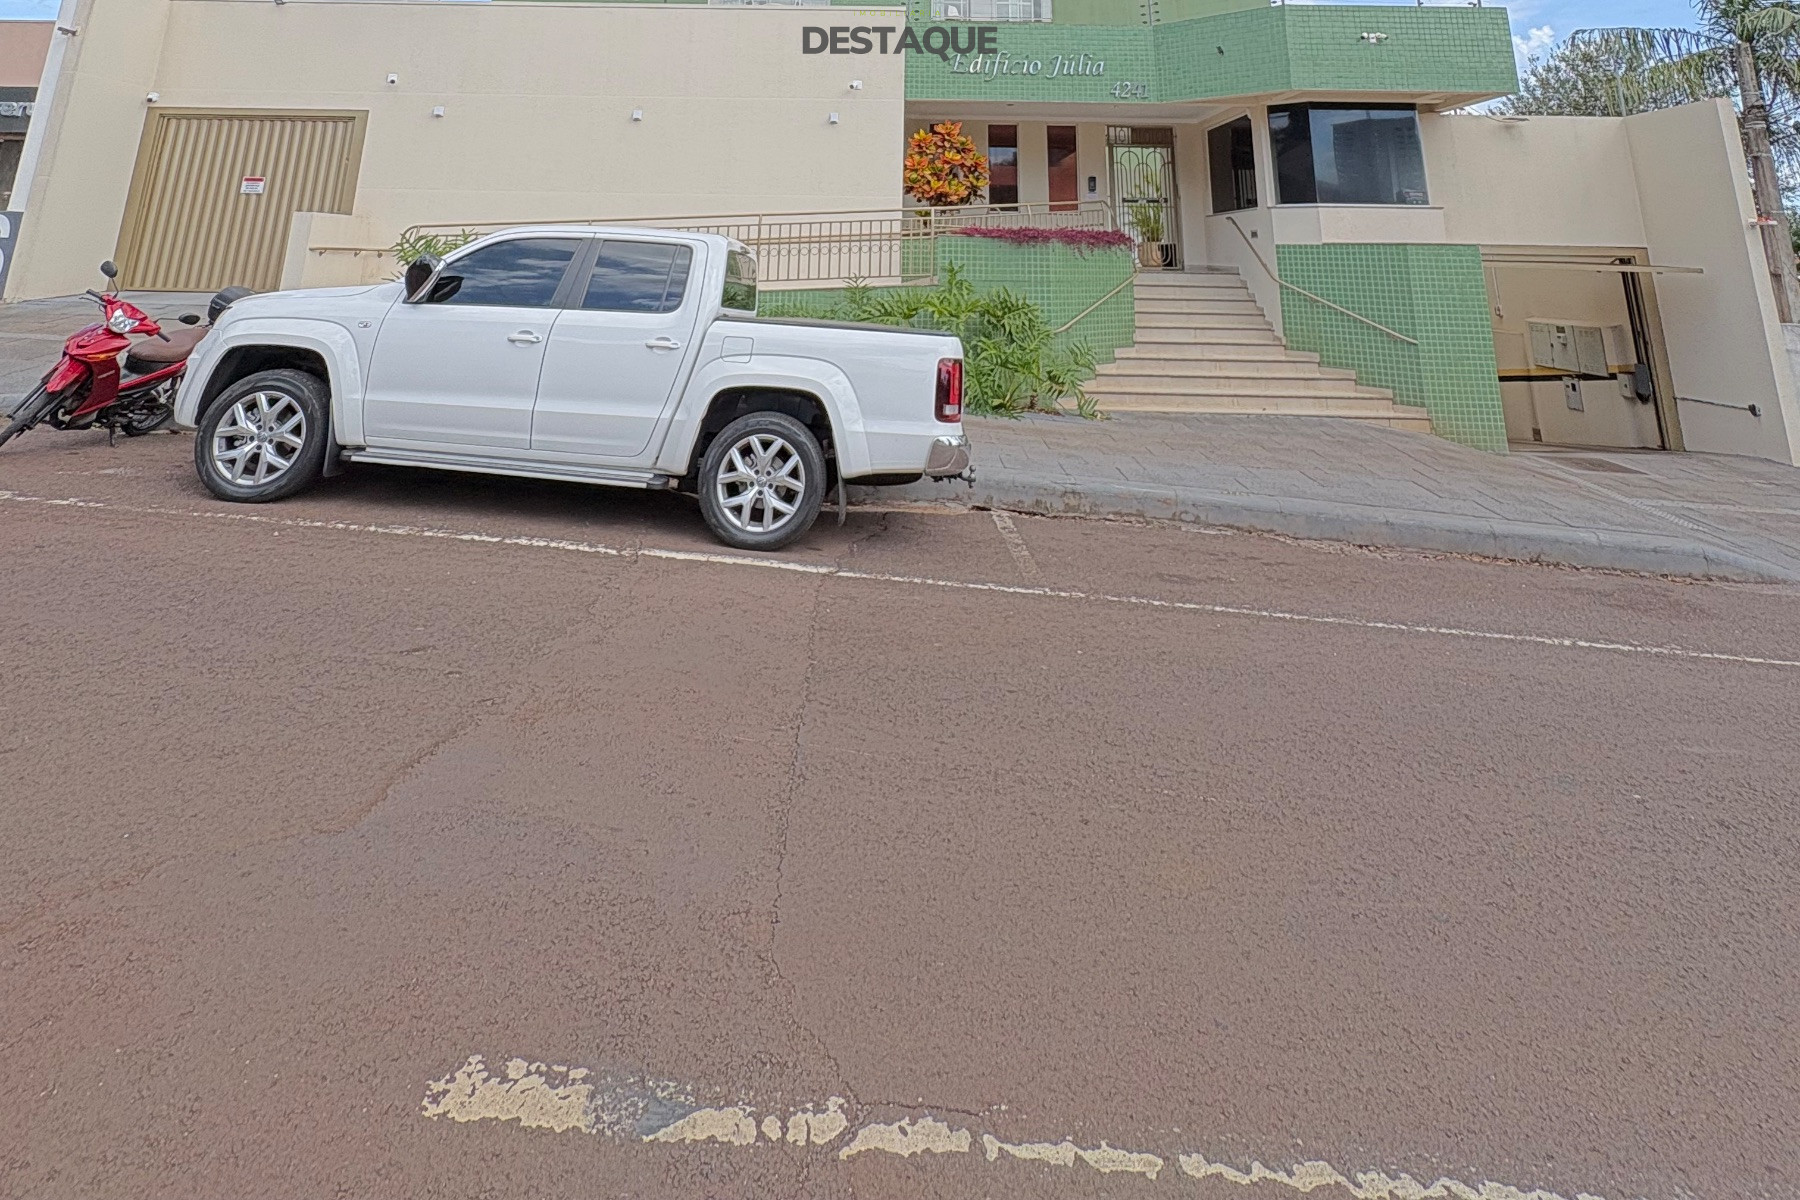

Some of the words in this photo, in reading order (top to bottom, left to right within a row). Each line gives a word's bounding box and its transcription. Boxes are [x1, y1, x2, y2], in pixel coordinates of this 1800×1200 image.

[950, 51, 1042, 82] Edifício
[1045, 52, 1105, 79] Júlia
[1110, 81, 1150, 99] 4241
